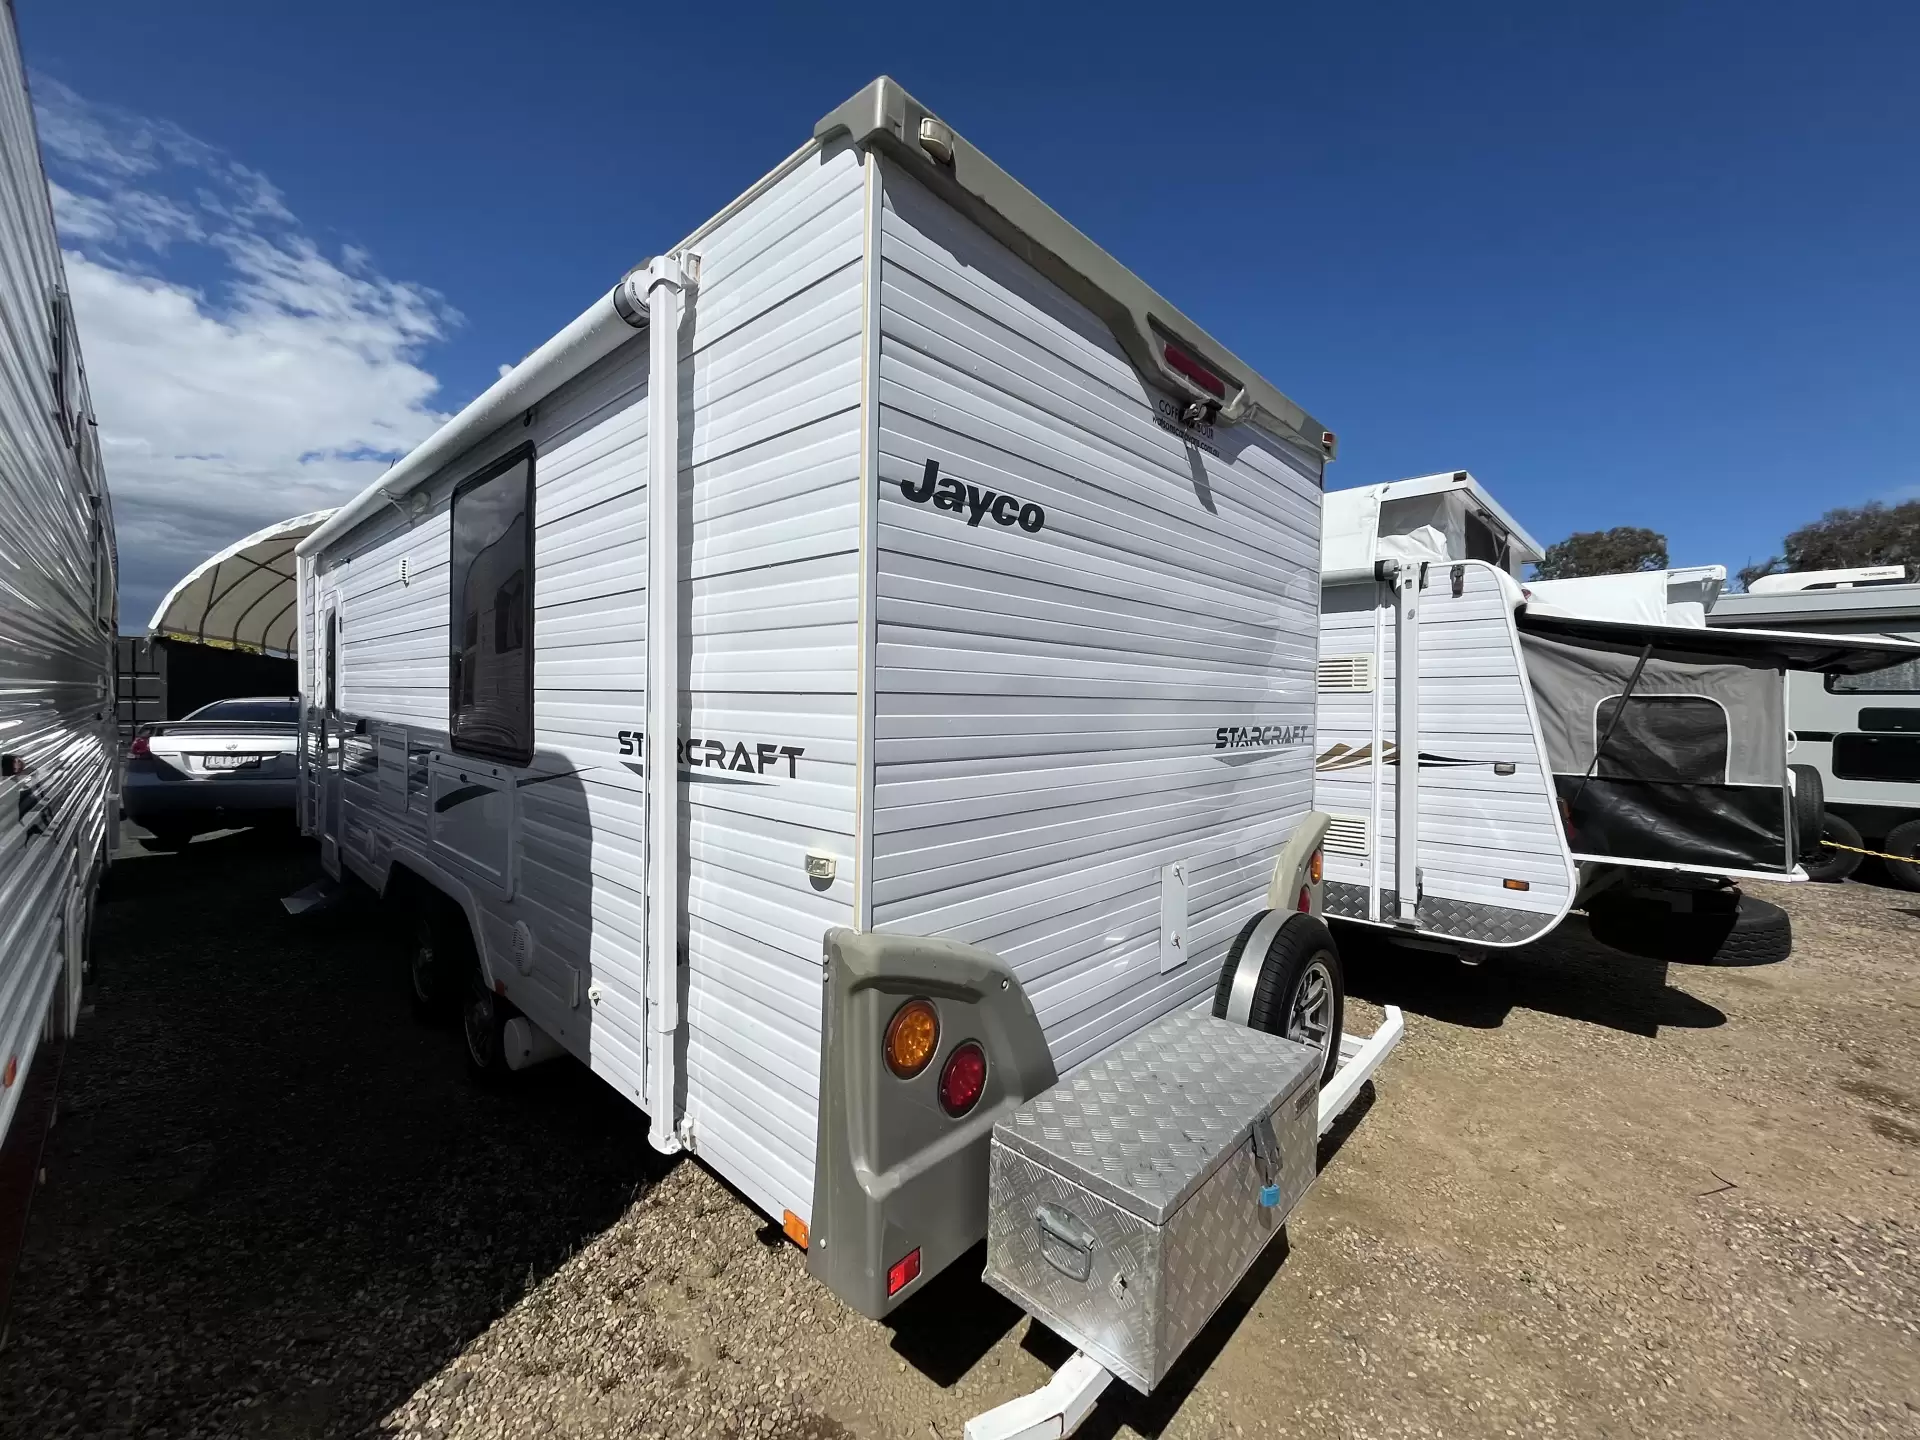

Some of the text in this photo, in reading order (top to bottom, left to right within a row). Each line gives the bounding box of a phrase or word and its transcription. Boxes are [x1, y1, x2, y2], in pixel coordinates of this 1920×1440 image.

[1159, 400, 1181, 421] COFF
[900, 459, 1045, 533] Jayco
[618, 730, 806, 779] STCRAFT
[1215, 726, 1308, 748] STARCRAFT
